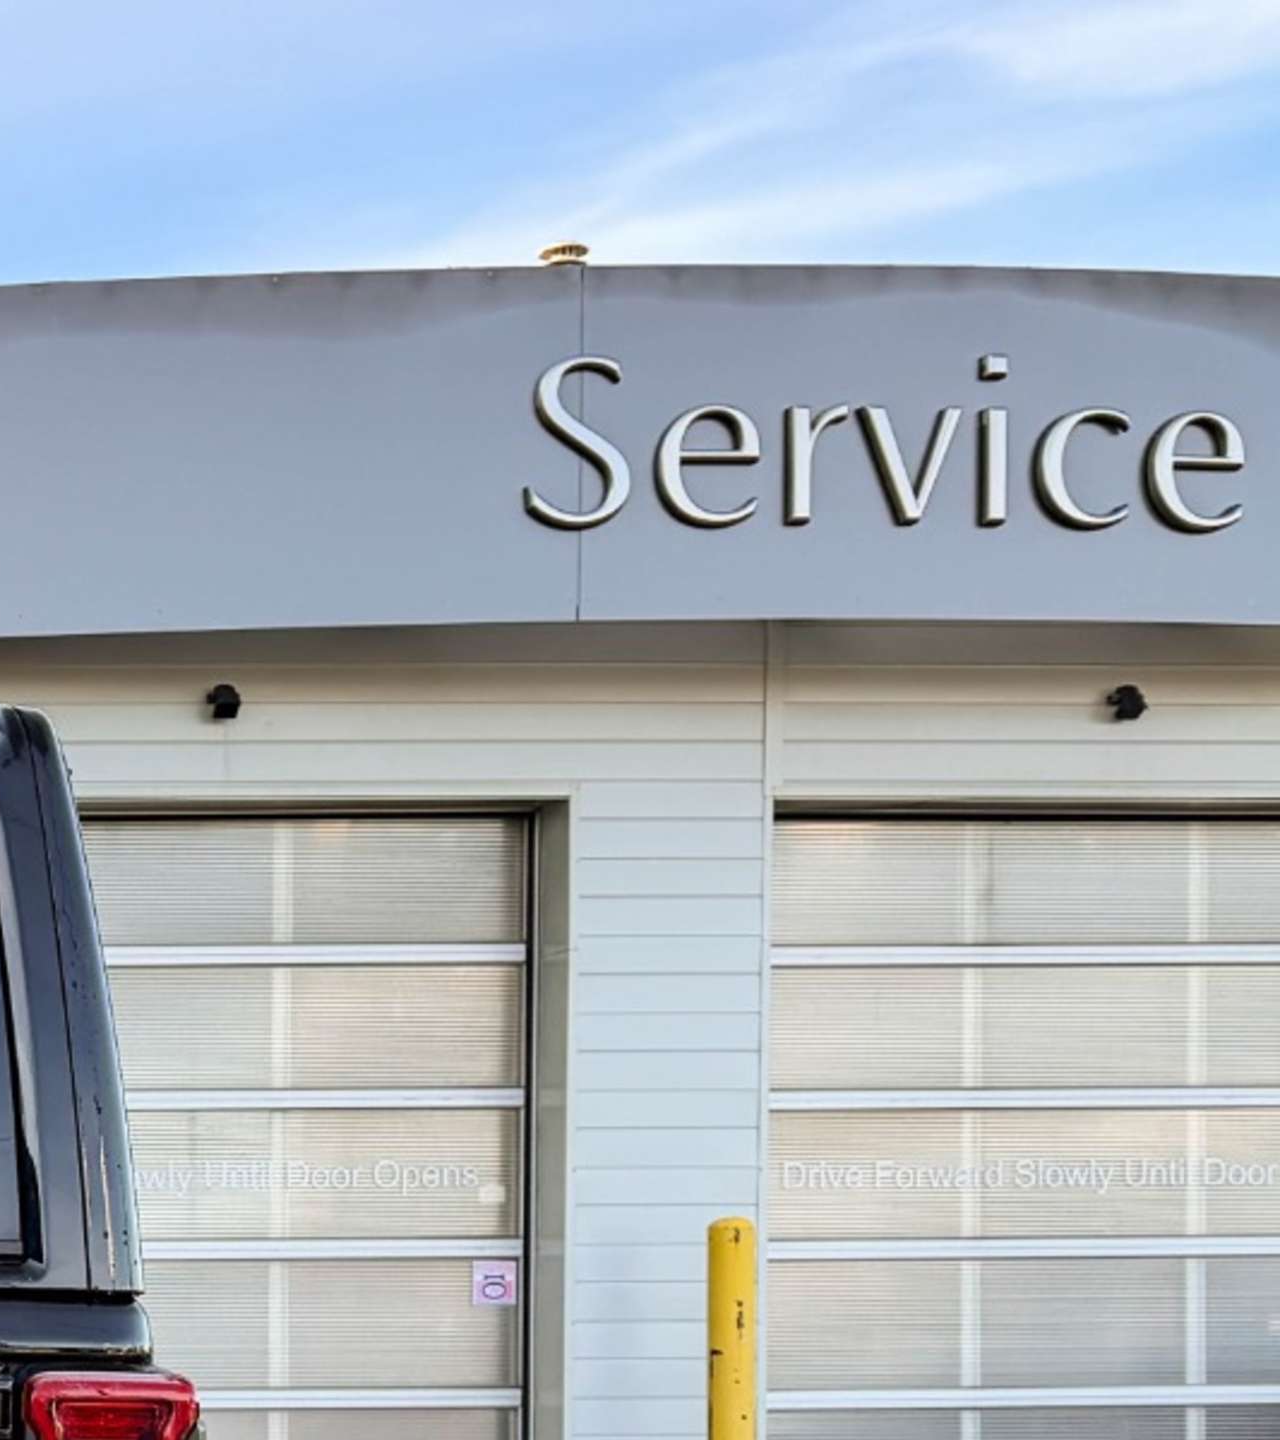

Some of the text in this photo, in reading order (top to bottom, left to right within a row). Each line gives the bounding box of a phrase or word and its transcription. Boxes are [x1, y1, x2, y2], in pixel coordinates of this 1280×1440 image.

[522, 354, 1246, 533] Service
[288, 1159, 365, 1189] Door
[373, 1158, 480, 1197] Opens
[782, 1158, 864, 1190] Drive
[873, 1158, 1004, 1190] Forward
[1014, 1158, 1113, 1195] Slowly
[1203, 1157, 1279, 1187] Door
